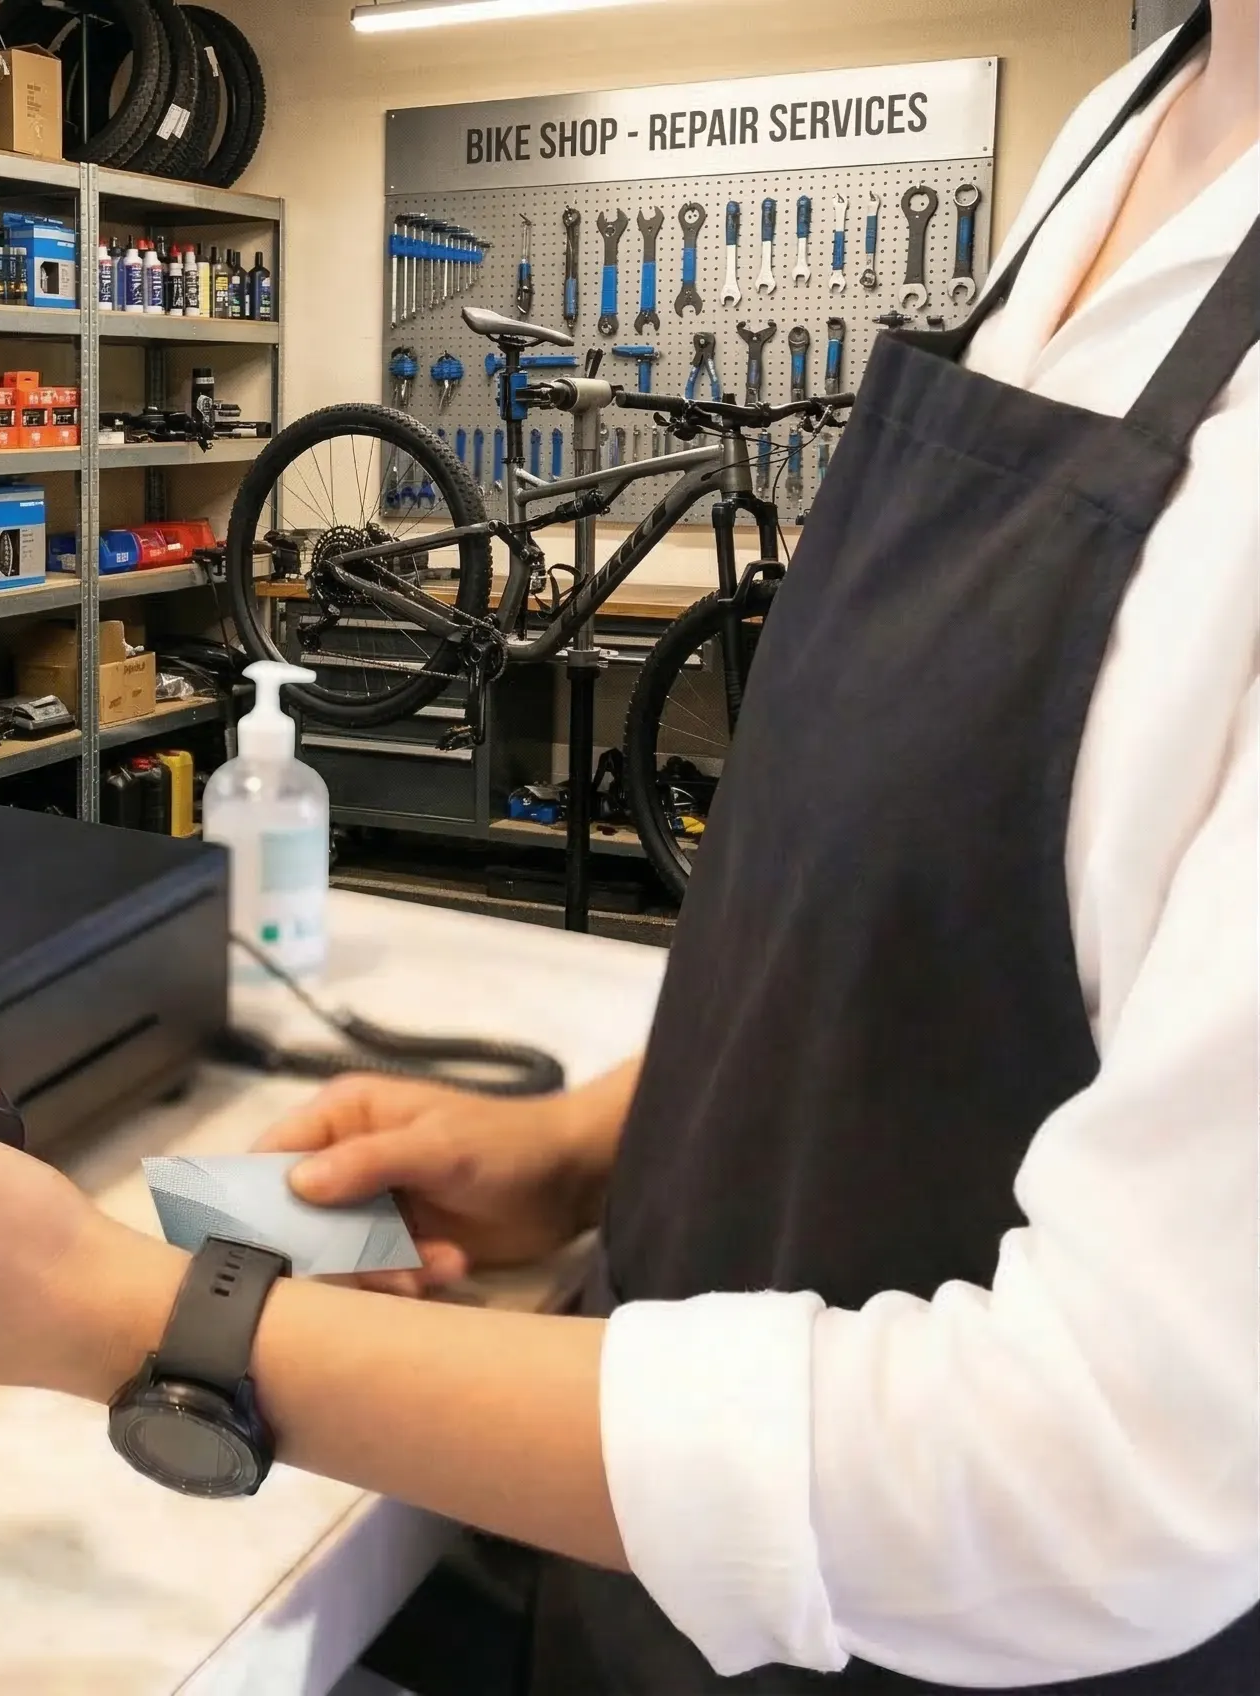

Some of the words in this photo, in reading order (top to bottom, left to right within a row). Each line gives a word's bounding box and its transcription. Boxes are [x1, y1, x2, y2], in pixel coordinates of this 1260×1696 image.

[466, 123, 531, 164] BIKE
[540, 117, 618, 160] SHOP
[627, 130, 639, 138] -
[649, 106, 759, 152] REPAIR
[769, 91, 928, 143] SERVICES
